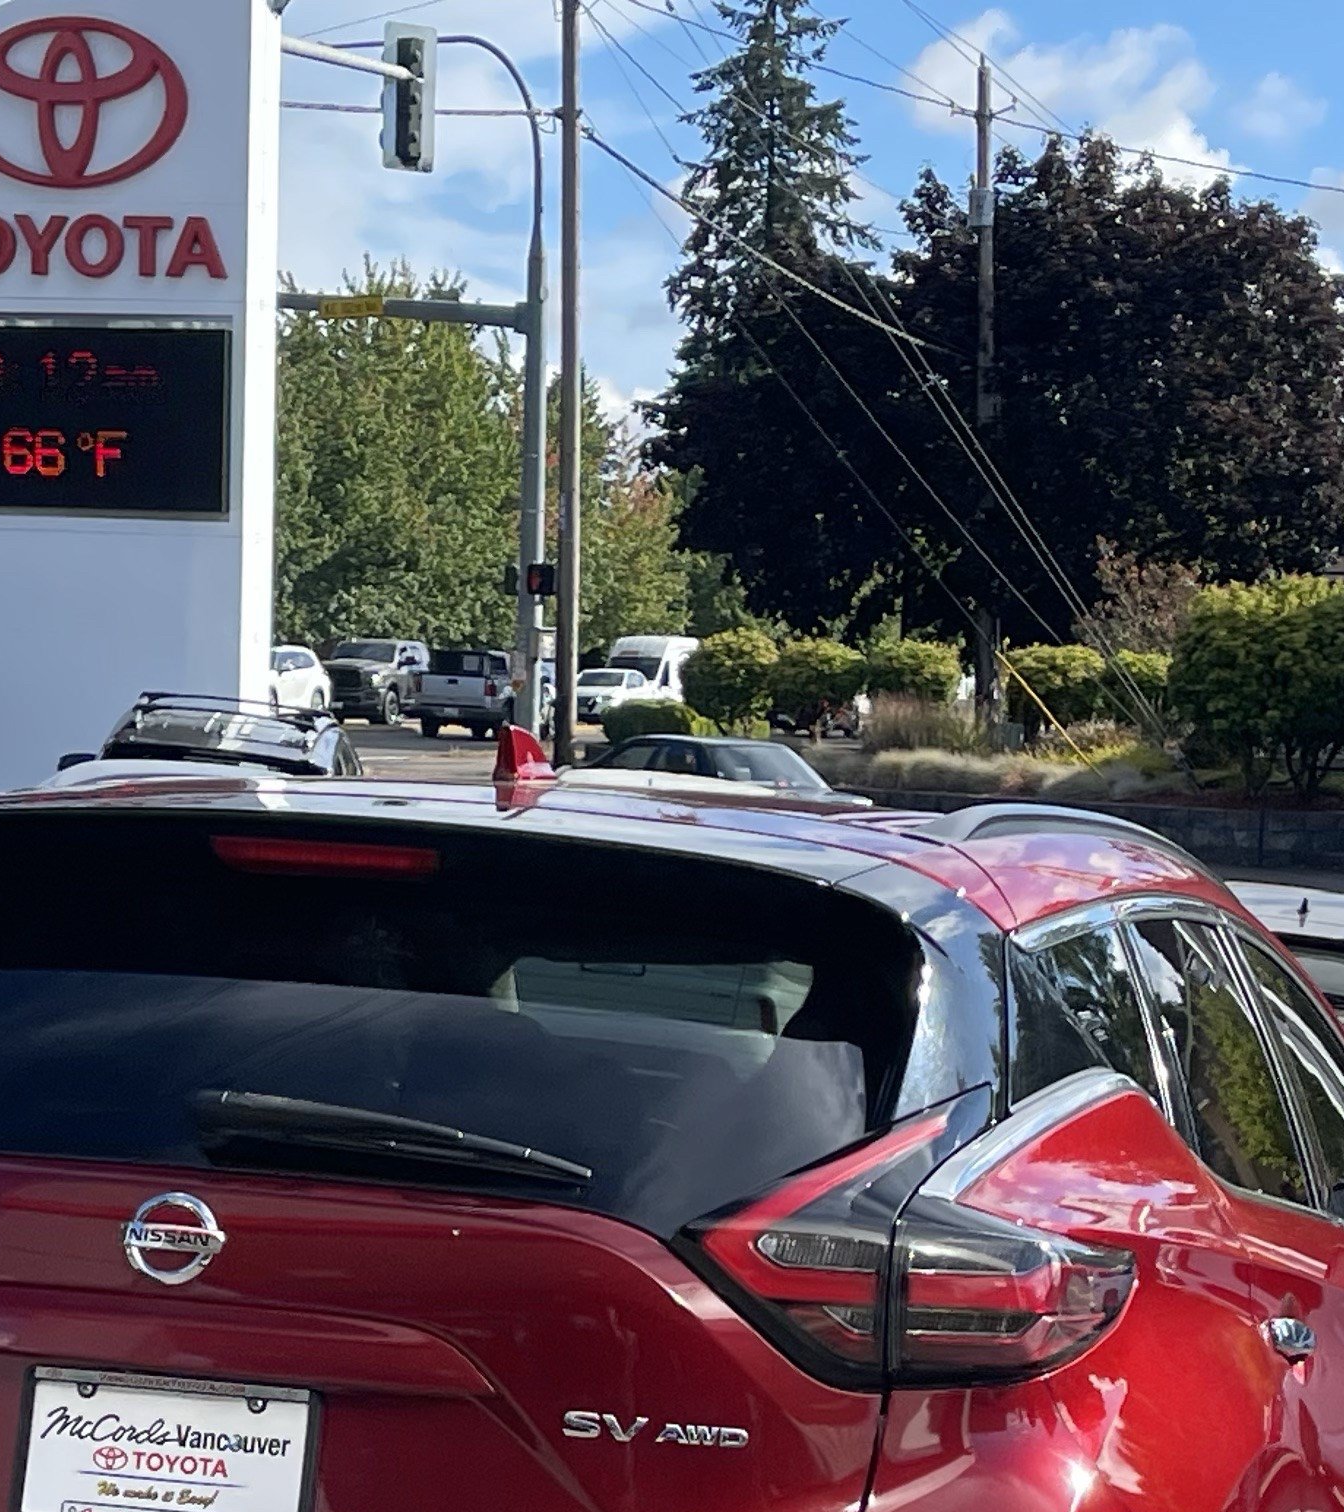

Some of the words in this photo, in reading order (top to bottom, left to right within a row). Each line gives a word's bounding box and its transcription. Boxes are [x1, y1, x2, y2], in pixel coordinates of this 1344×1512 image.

[128, 1226, 211, 1247] NISSAN
[39, 1405, 175, 1446] McCords
[175, 1424, 292, 1458] Vancouver
[561, 1409, 650, 1443] SV
[655, 1422, 750, 1448] AWD
[132, 1450, 229, 1479] TOYOTA
